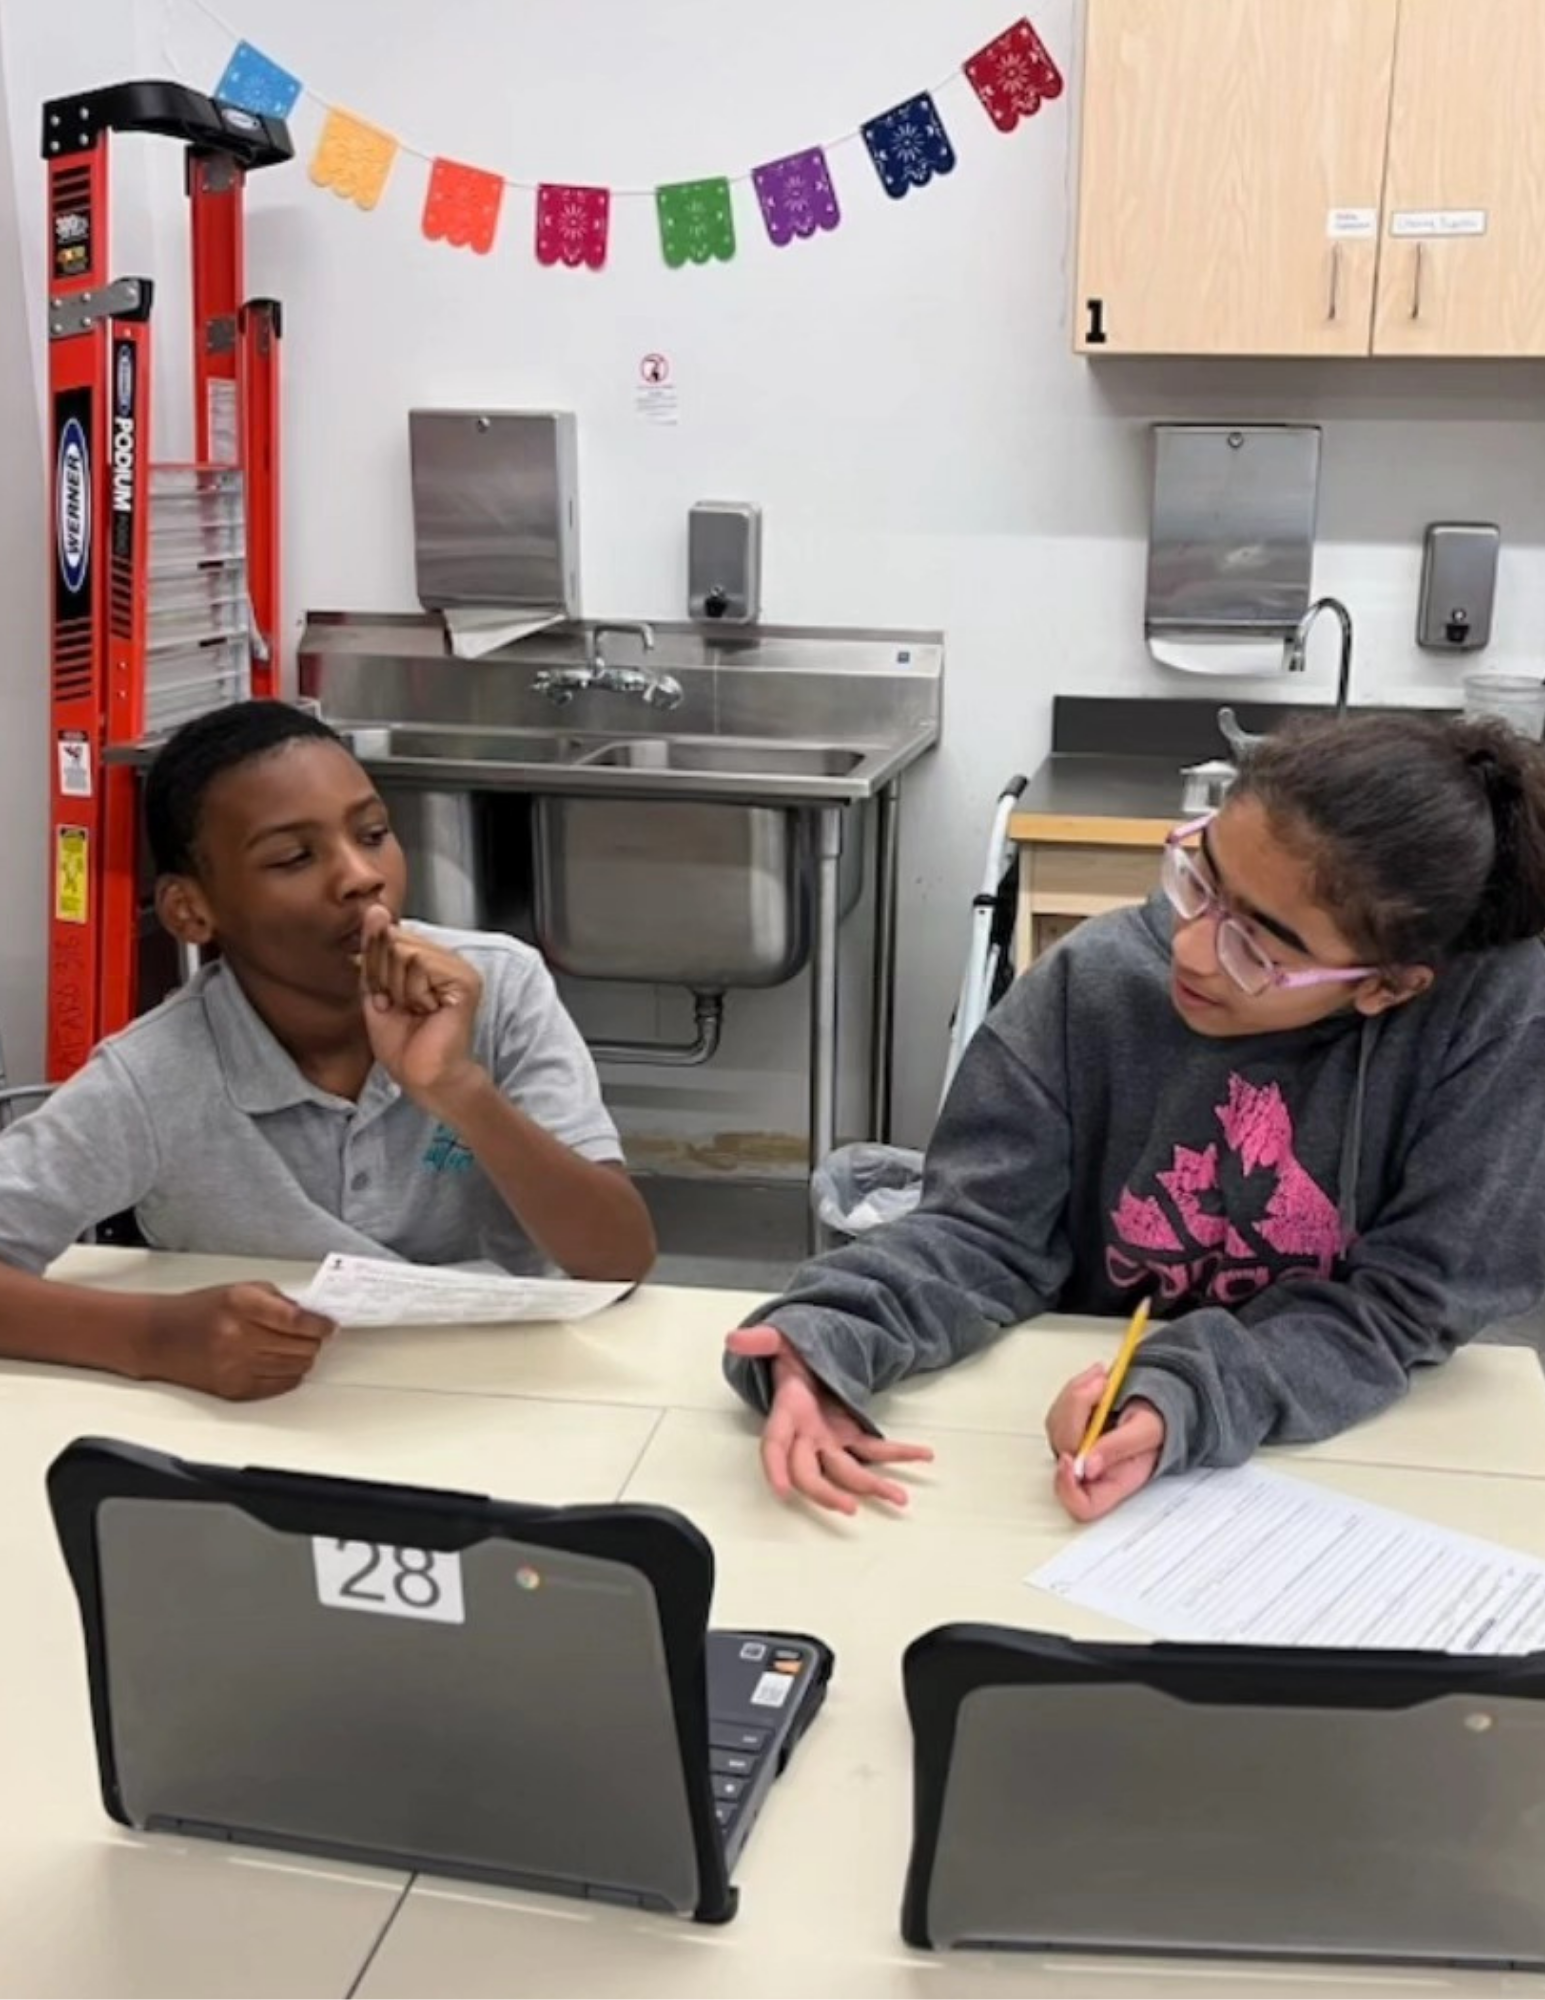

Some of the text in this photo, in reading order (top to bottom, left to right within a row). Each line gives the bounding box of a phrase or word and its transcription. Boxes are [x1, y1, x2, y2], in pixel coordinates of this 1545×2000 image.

[1086, 299, 1106, 343] 1
[67, 454, 82, 554] WERNER
[113, 417, 135, 513] PODIUM
[336, 1540, 441, 1609] 28
